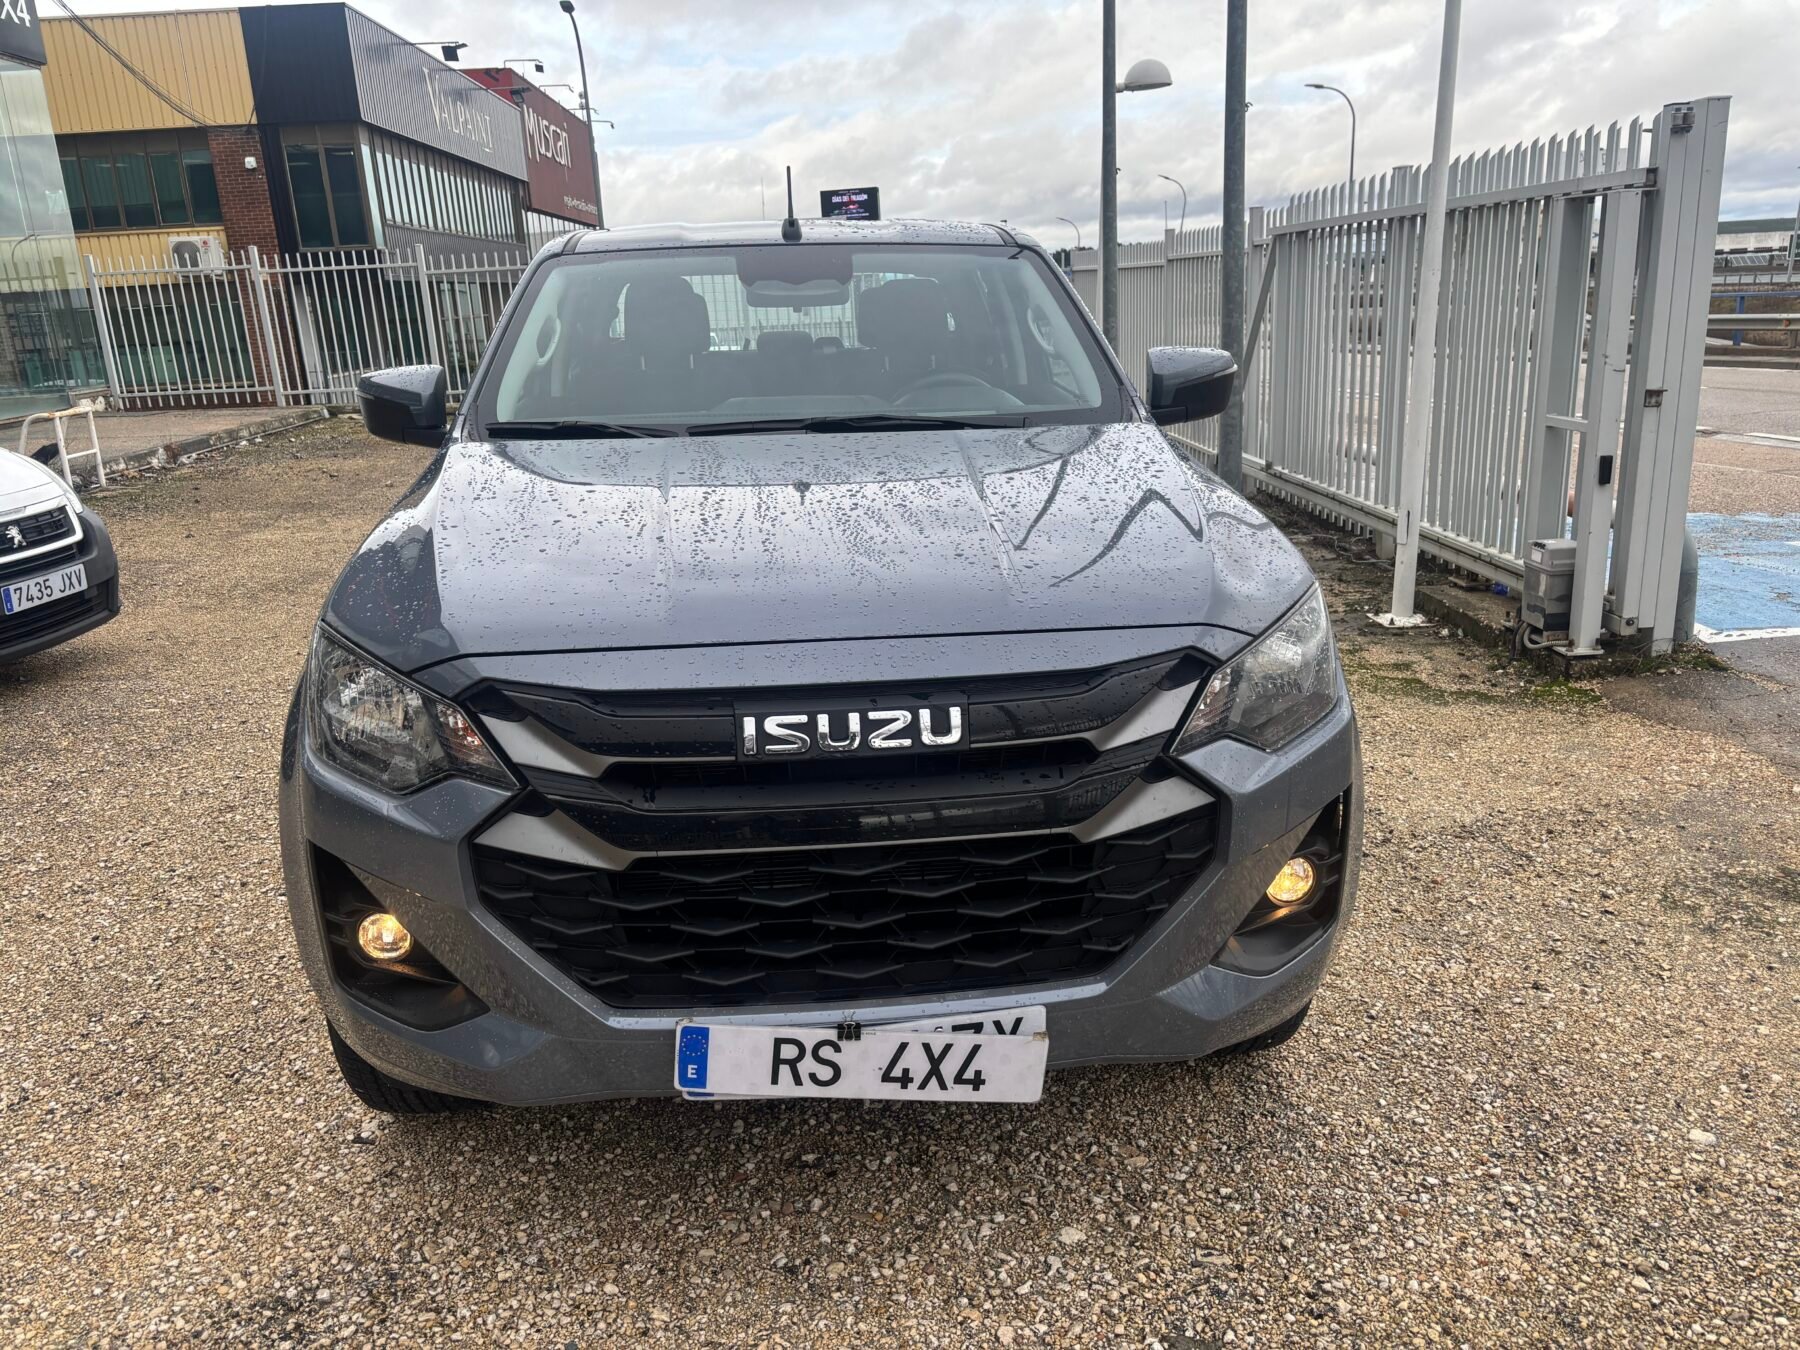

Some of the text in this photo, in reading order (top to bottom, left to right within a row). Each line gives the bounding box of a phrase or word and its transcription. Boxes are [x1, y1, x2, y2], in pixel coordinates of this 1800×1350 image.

[14, 568, 82, 607] 7435 JXV
[743, 706, 962, 755] ISUZU
[687, 1064, 698, 1079] E
[770, 1037, 987, 1092] RS 4X4
